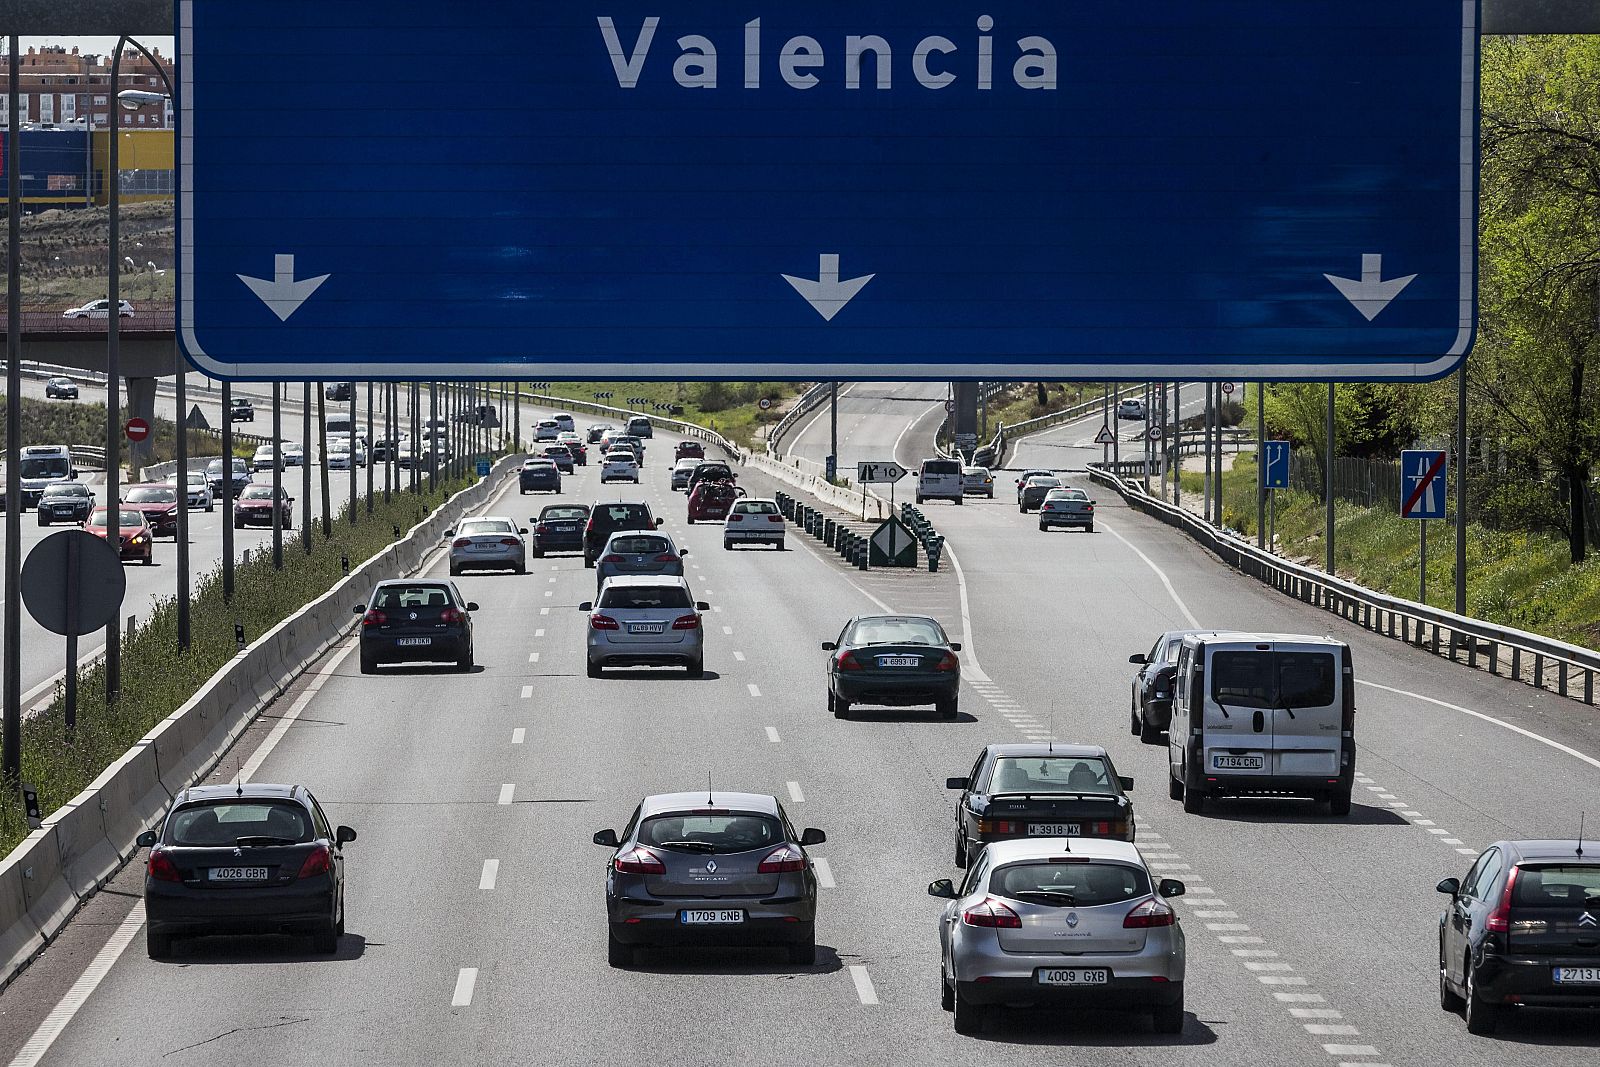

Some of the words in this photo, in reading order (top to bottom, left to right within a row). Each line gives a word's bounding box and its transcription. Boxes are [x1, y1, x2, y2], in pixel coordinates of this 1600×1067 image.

[597, 15, 1057, 90] Valencia
[883, 468, 897, 478] 10
[890, 658, 907, 666] 6993
[909, 658, 918, 666] UF
[1219, 757, 1242, 767] 7194
[1243, 757, 1260, 767] CRL
[216, 868, 244, 879] 4026
[245, 868, 266, 879] GBR
[690, 911, 716, 921] 1709
[720, 911, 740, 921] GNB
[1047, 970, 1076, 982] 4009
[1083, 970, 1105, 982] GXB
[1563, 969, 1593, 980] 2713
